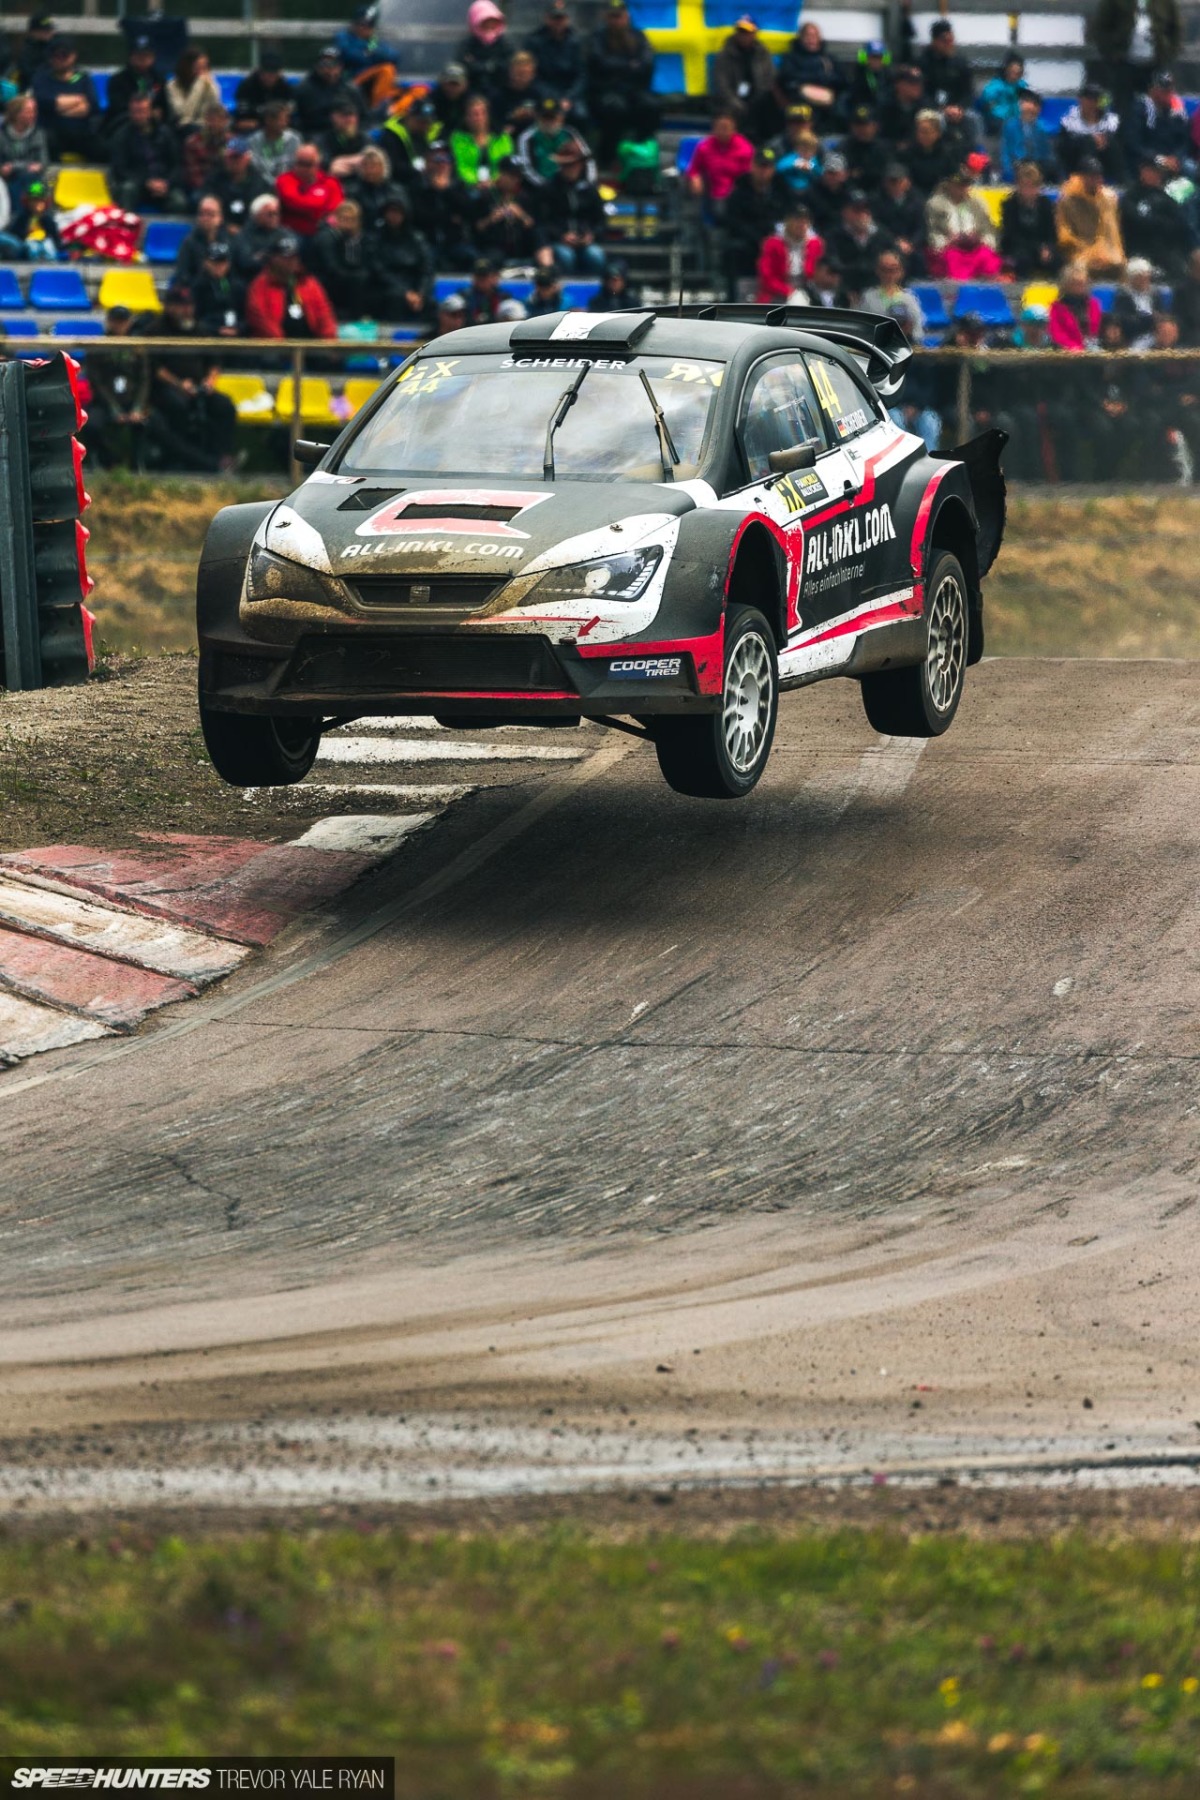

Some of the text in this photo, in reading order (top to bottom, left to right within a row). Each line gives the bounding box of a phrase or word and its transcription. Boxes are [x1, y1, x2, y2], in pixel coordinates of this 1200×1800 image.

[500, 358, 627, 370] SCHEIDER
[399, 379, 439, 395] 44
[808, 360, 842, 418] 44
[609, 658, 682, 672] COOPER
[645, 668, 680, 677] TIRES
